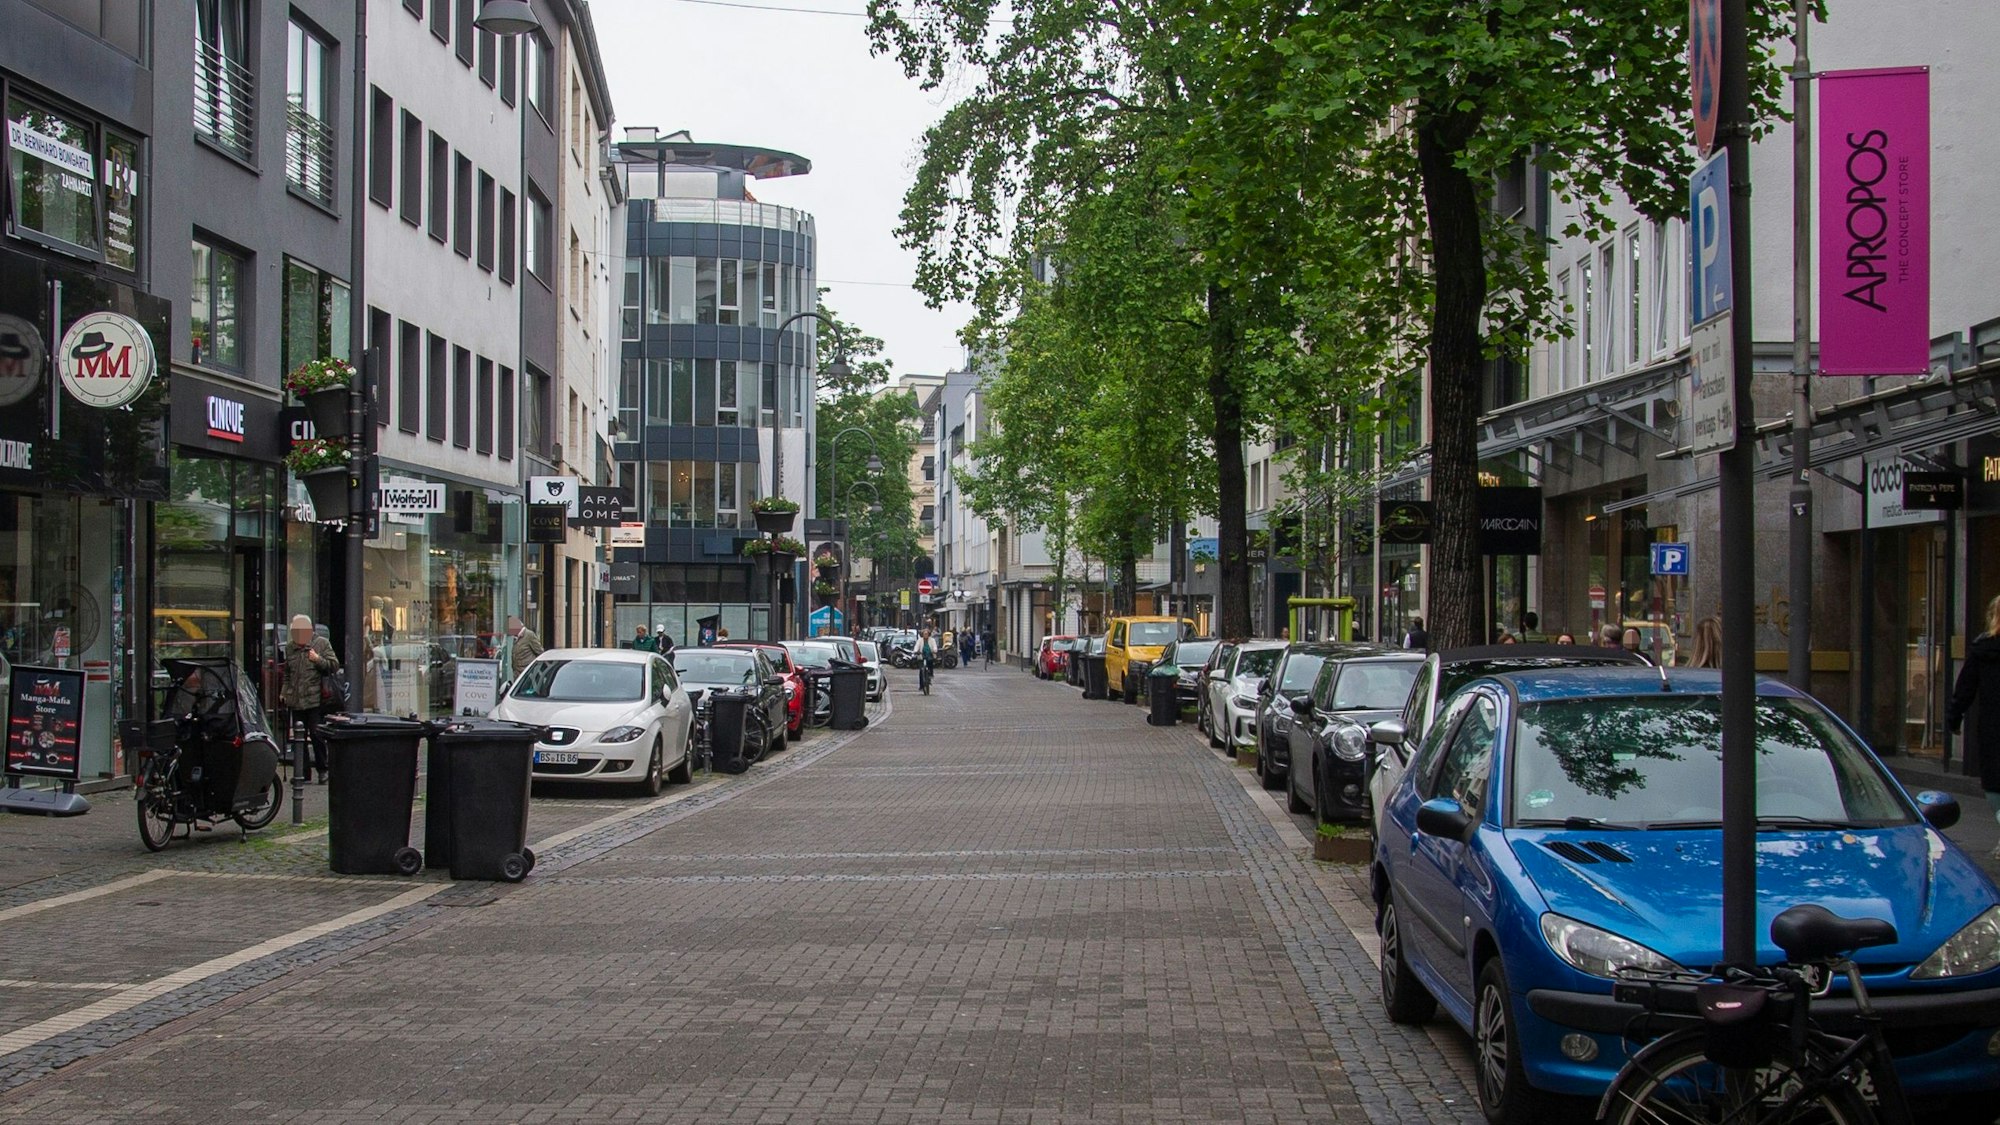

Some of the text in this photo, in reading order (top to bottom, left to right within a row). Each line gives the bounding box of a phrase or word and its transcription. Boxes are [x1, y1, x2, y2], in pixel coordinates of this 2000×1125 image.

[12, 127, 90, 173] DR. BERNHARD BONGARTZ
[61, 172, 92, 198] ZAHNARZT
[1842, 130, 1888, 313] APROPOS
[1899, 155, 1909, 284] THE CONCEPT STORE
[1699, 186, 1720, 320] P
[75, 345, 132, 378] MM
[208, 395, 244, 435] CINQUE
[389, 493, 427, 505] Wolford
[583, 495, 620, 505] ARA
[583, 510, 620, 519] OME
[21, 693, 71, 705] Manga-Mafia
[464, 690, 488, 699] cove
[36, 704, 56, 714] Store
[540, 753, 577, 763] BS IG 86
